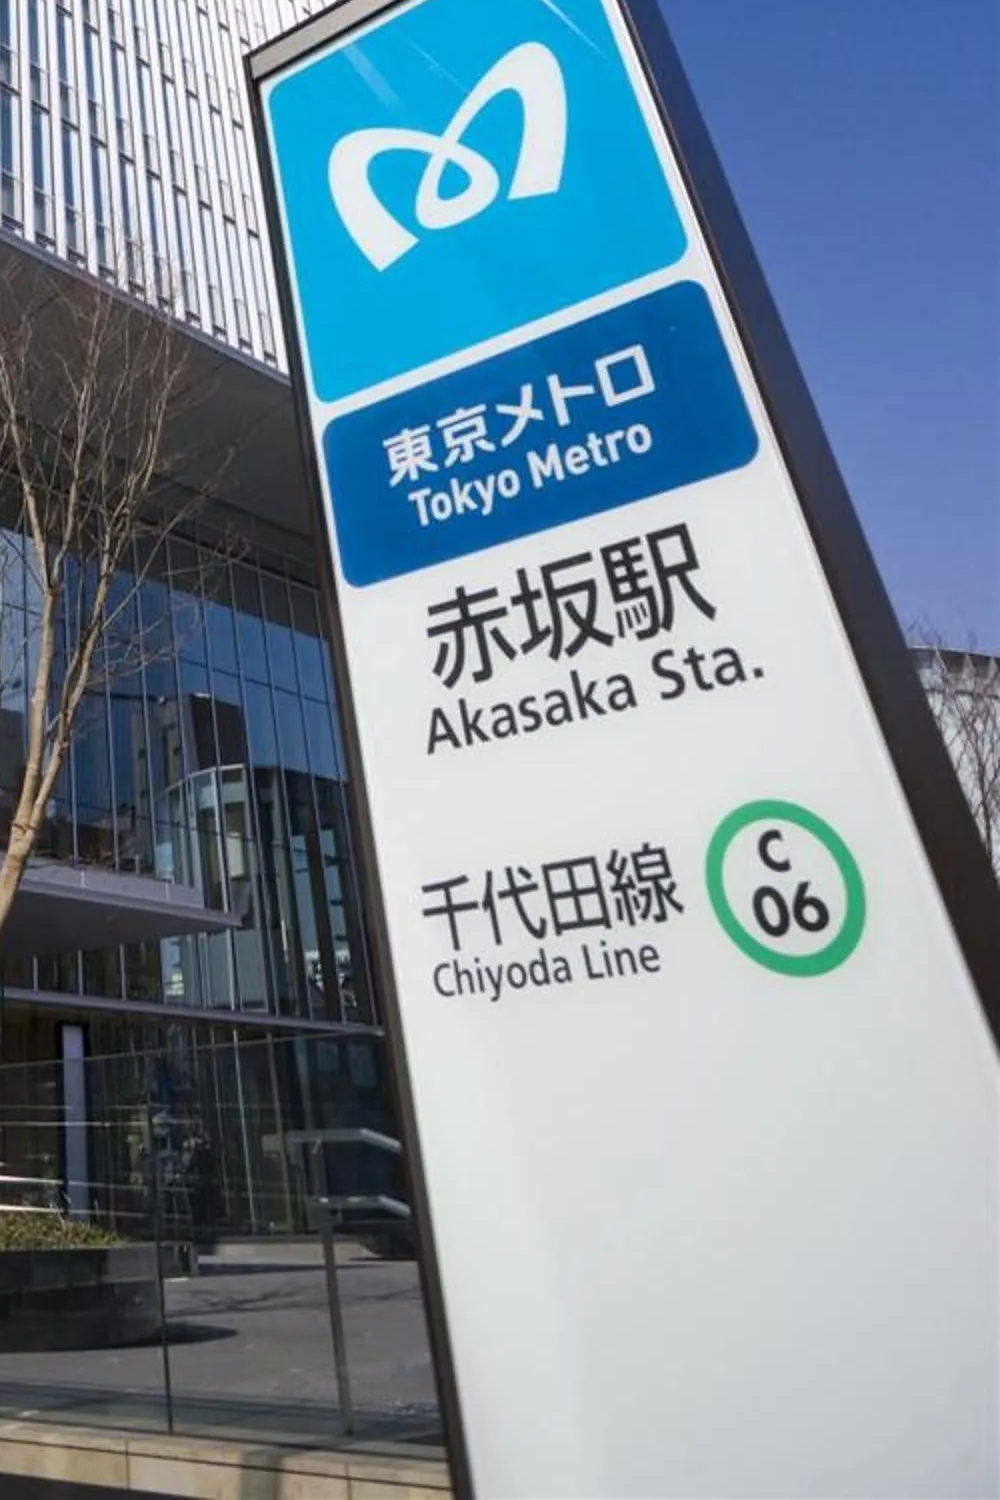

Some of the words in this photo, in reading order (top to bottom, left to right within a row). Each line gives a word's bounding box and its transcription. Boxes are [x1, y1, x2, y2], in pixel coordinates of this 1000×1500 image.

[384, 346, 654, 485] 東京メトロ
[409, 470, 519, 525] Tokyo
[528, 425, 651, 487] Metro
[428, 523, 715, 688] 赤坂駅
[428, 671, 636, 754] Akasaka
[653, 648, 763, 699] Sta.
[422, 843, 683, 950] 千代田線
[759, 830, 790, 872] C
[753, 883, 830, 937] 06
[434, 935, 571, 1001] Chiyoda
[583, 941, 659, 979] Line
